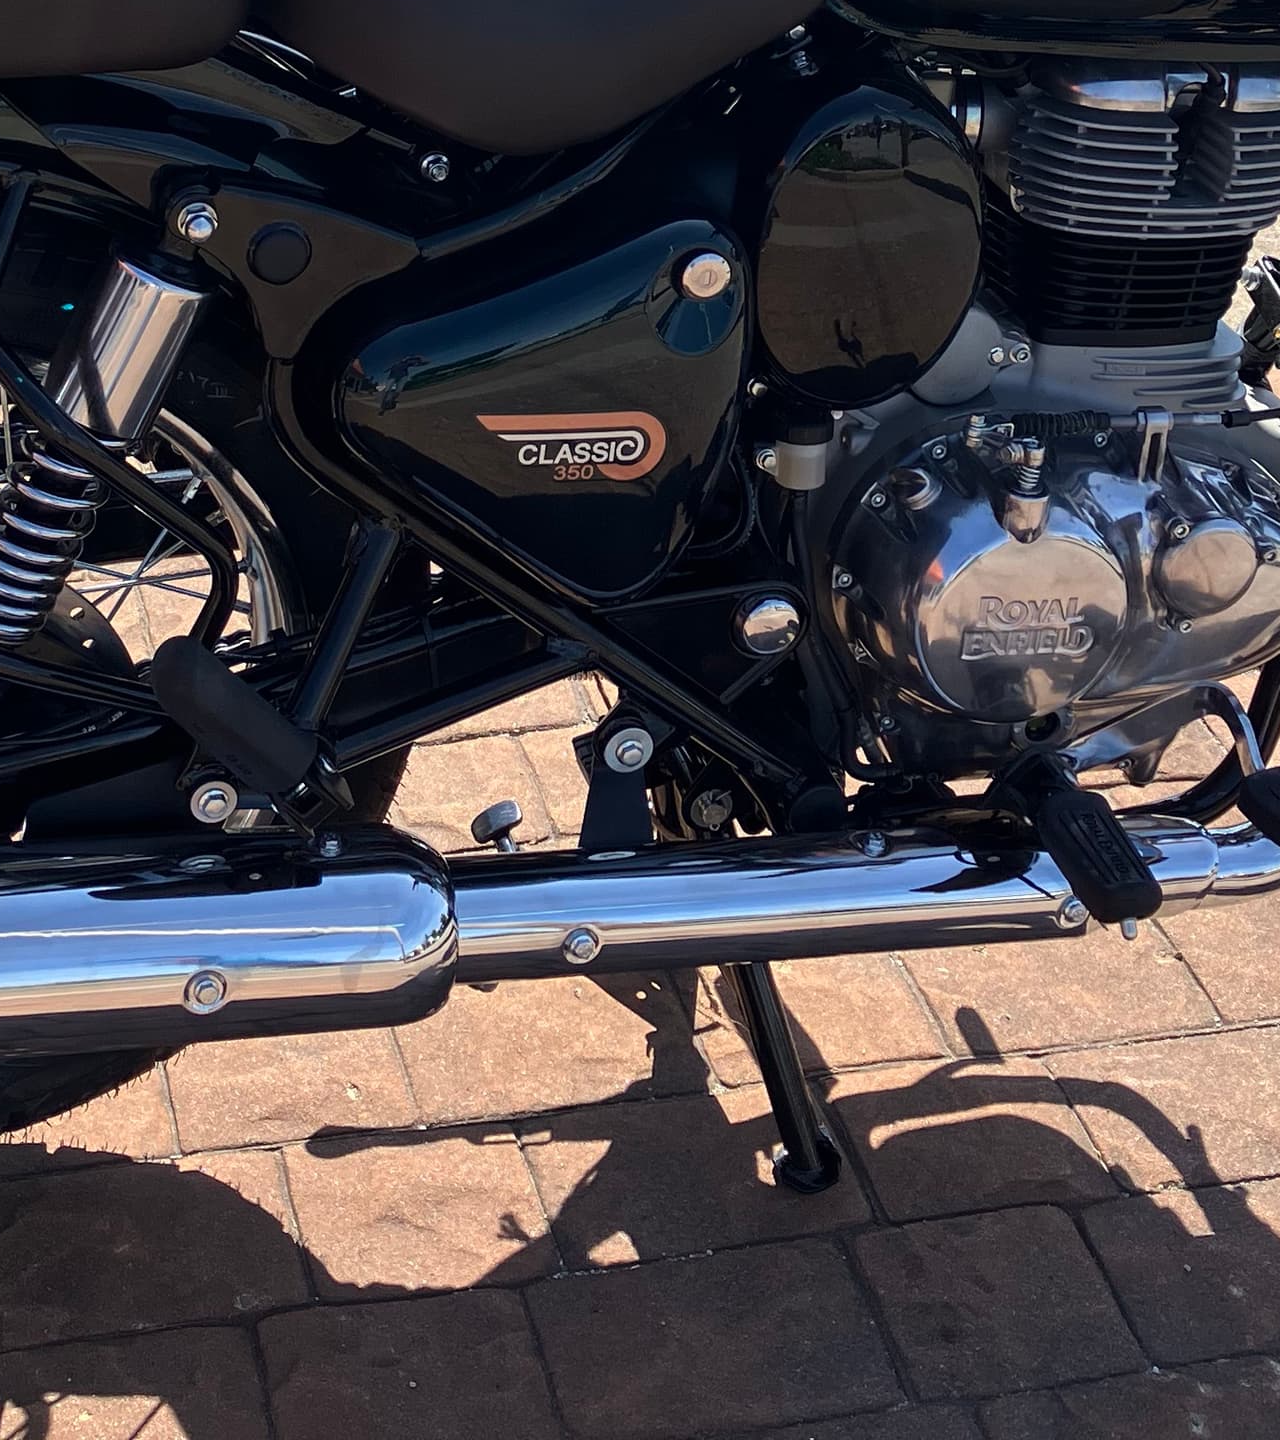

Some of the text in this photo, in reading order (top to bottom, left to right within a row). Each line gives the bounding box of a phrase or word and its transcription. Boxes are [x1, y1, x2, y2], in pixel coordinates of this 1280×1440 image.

[518, 436, 644, 466] CLASSIC
[553, 465, 594, 481] 350
[976, 596, 1085, 630] ROYAL
[961, 625, 1096, 661] ENFIELD
